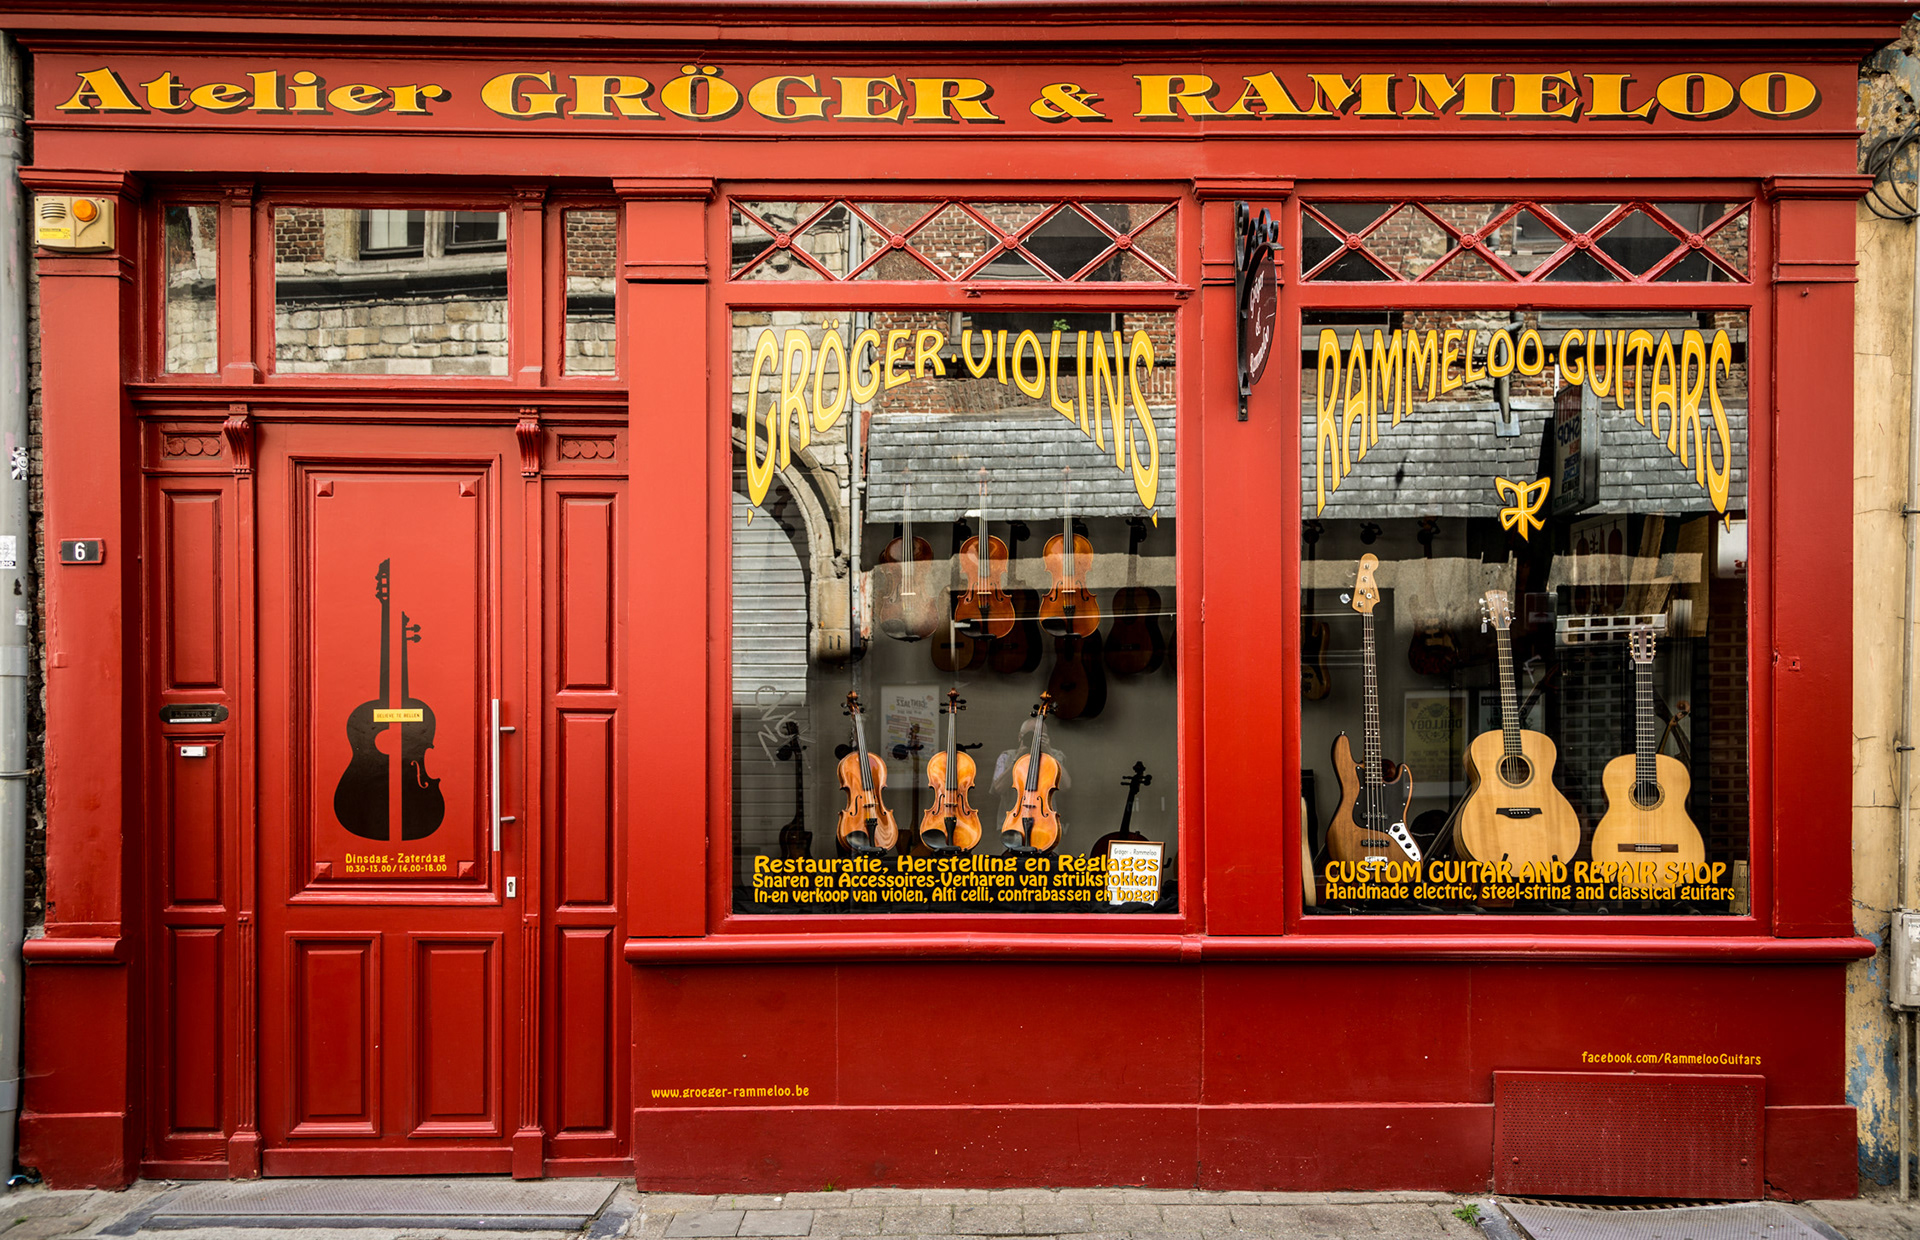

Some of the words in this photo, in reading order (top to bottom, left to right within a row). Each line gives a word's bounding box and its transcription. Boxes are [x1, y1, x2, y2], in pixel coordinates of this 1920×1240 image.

[56, 67, 448, 114] Atelier
[481, 64, 1003, 121] GRÖGER
[1030, 83, 1109, 120] &
[1134, 70, 1821, 119] RAMMELOO
[75, 542, 86, 561] 6
[345, 853, 388, 864] Dinsdag
[397, 853, 446, 863] Zaterdag
[754, 855, 889, 873] Restauratie,
[897, 854, 1017, 872] Herstelling
[1025, 858, 1051, 872] en
[1058, 853, 1159, 872] Réglages
[752, 873, 810, 888] Snaren
[814, 875, 834, 888] en
[1019, 874, 1048, 887] van
[1053, 872, 1157, 887] strijkstokken
[1325, 860, 1421, 883] CUSTOM
[1429, 860, 1513, 883] GUITAR
[1518, 860, 1568, 884] AND
[1573, 860, 1658, 884] REPAIR
[1663, 861, 1727, 884] SHOP
[792, 887, 849, 902] verkoop
[853, 889, 878, 902] van
[881, 887, 928, 903] violen,
[932, 887, 957, 902] Alti
[960, 886, 994, 903] celli,
[997, 886, 1091, 902] contrabassen
[1095, 889, 1113, 902] en
[1116, 886, 1159, 902] bogen
[1325, 883, 1409, 899] Handmade
[1413, 882, 1477, 901] electric,
[1481, 882, 1572, 900] steel-string
[1575, 883, 1605, 899] and
[1609, 882, 1676, 899] classical
[1680, 884, 1736, 901] guitars
[1581, 1050, 1762, 1067] facebook.com/RammelooGuitars
[651, 1084, 810, 1099] www.groeger-rammeloo.be
